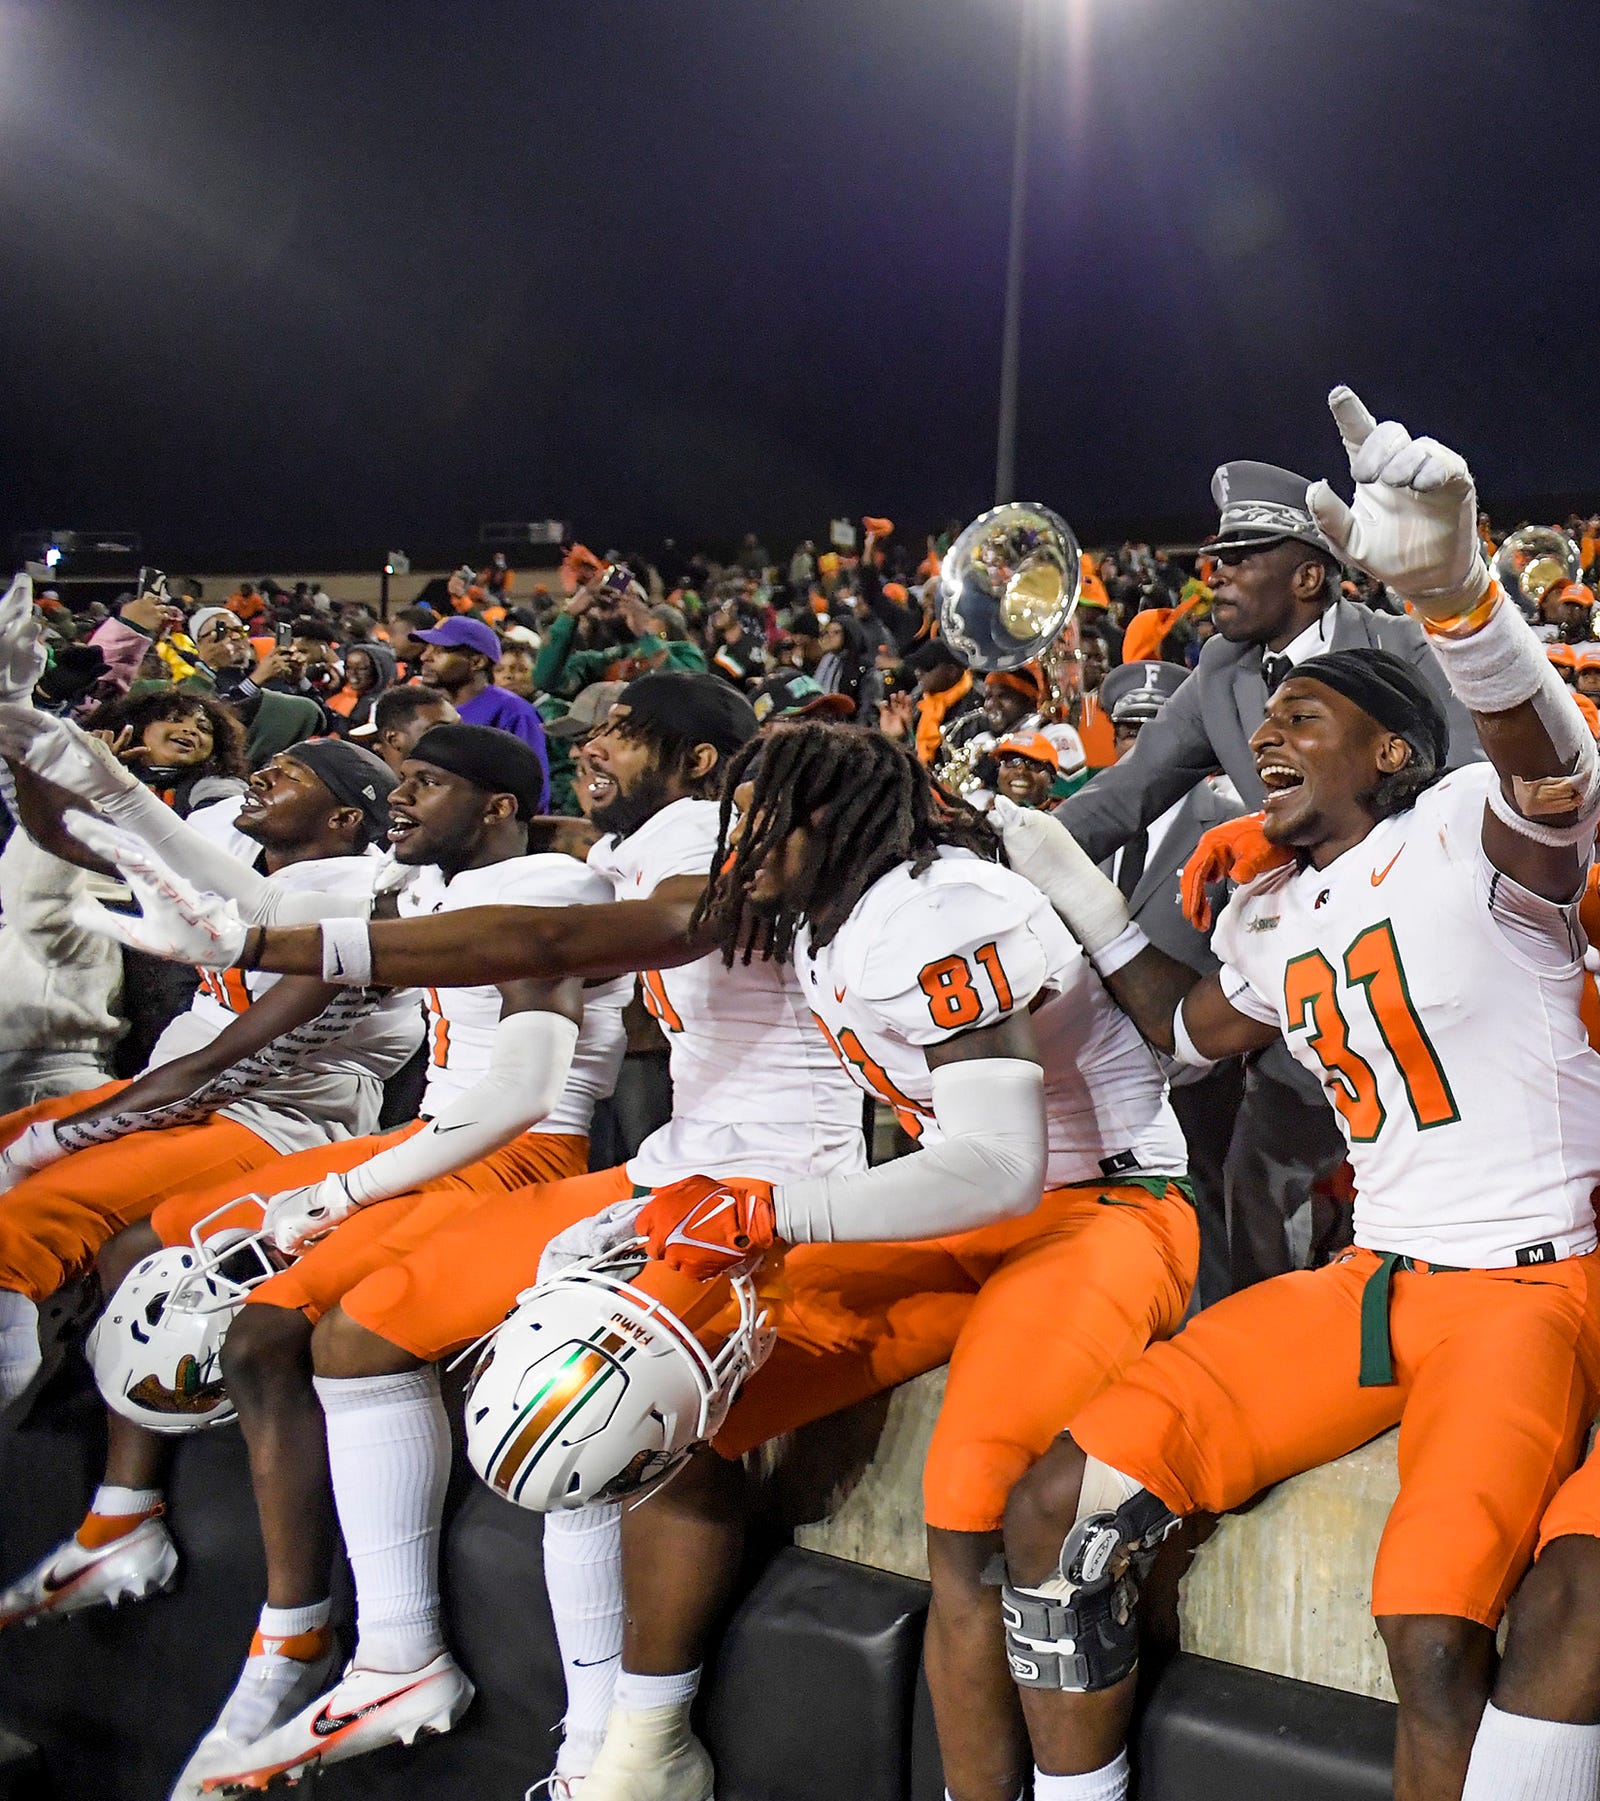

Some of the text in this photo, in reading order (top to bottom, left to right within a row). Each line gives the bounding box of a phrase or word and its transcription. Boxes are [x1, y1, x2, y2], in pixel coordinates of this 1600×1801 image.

[1216, 466, 1230, 504] F
[1144, 664, 1161, 689] F
[917, 941, 1013, 1030] 81
[1284, 917, 1462, 1143] 31
[1113, 1157, 1125, 1169] L
[1529, 1248, 1544, 1262] M
[611, 1312, 655, 1346] FAMU
